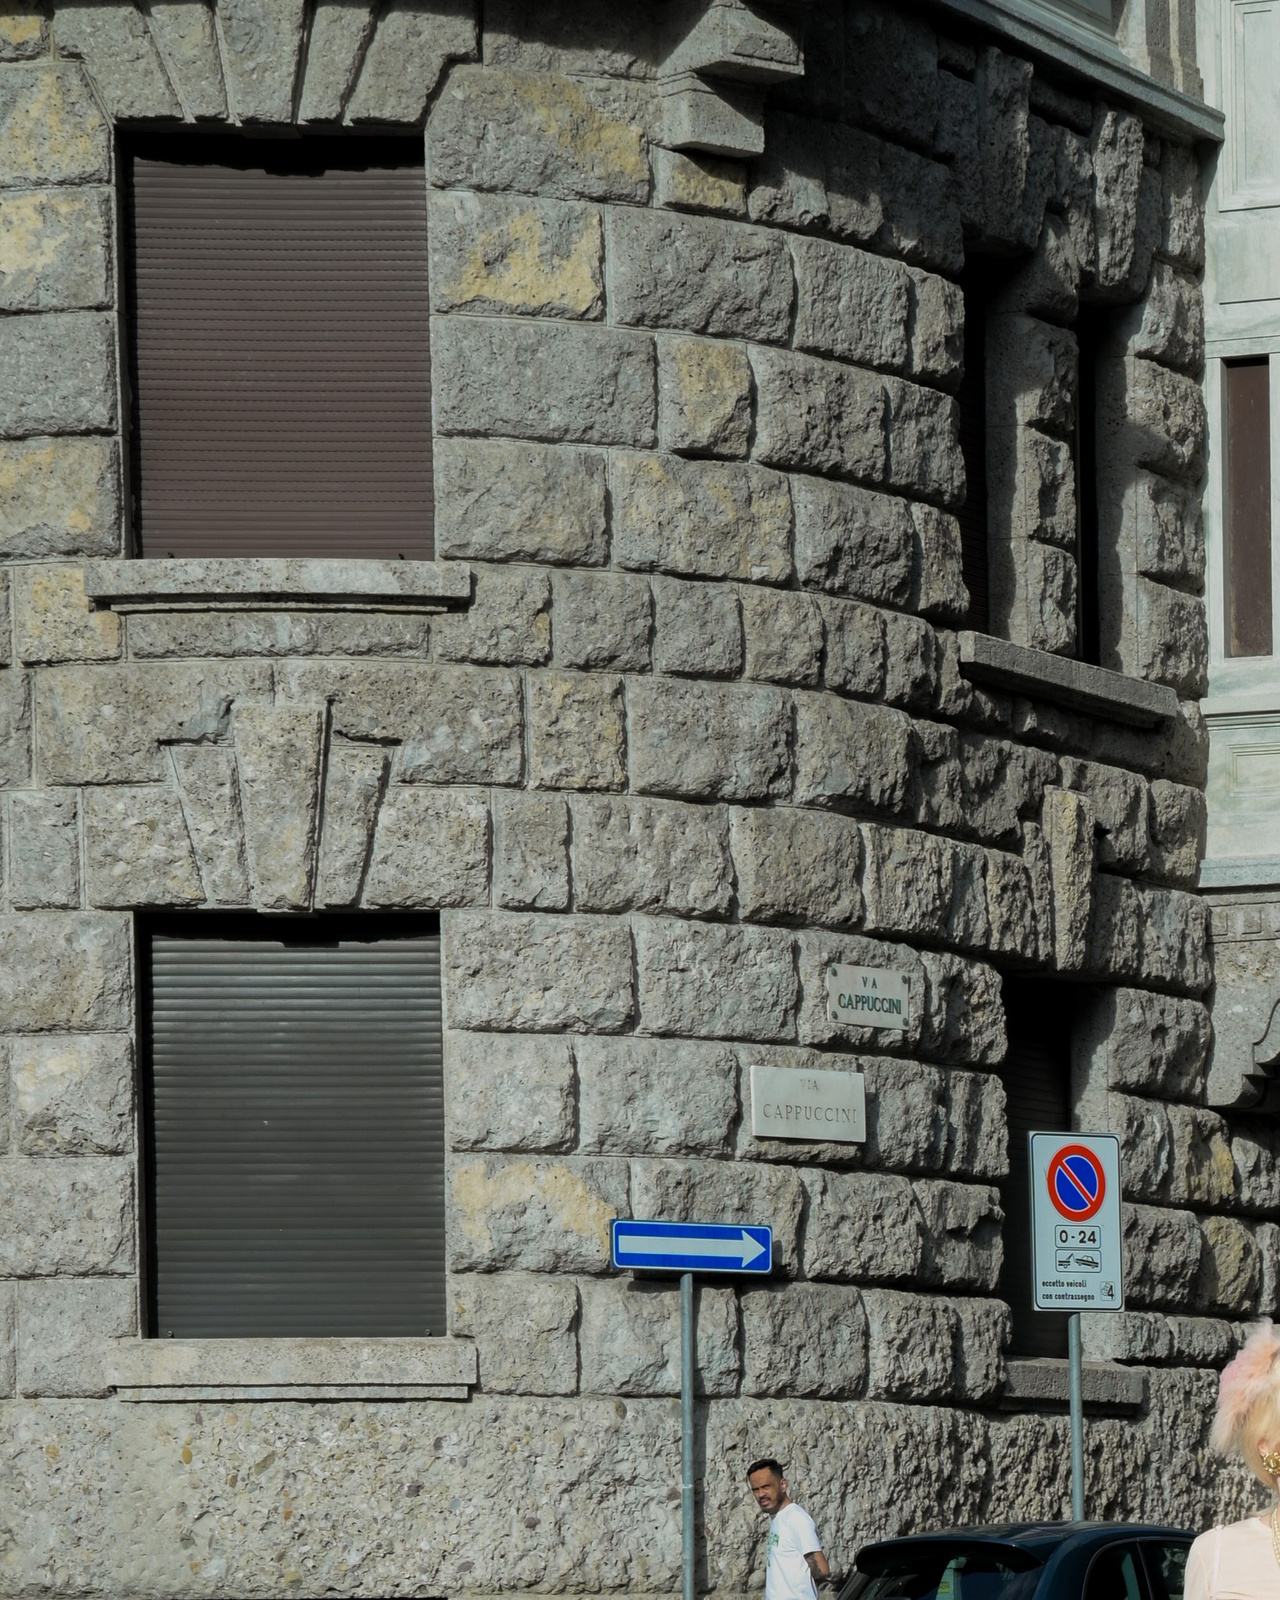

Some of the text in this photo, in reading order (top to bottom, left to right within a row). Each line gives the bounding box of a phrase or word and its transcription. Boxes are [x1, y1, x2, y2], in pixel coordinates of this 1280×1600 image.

[838, 993, 902, 1015] CAPPUCCINI
[799, 1078, 819, 1091] VIA
[762, 1103, 856, 1123] CAPPUCCINI
[1042, 1279, 1087, 1288] eccetto veicoli
[1054, 1292, 1095, 1302] contrassegno
